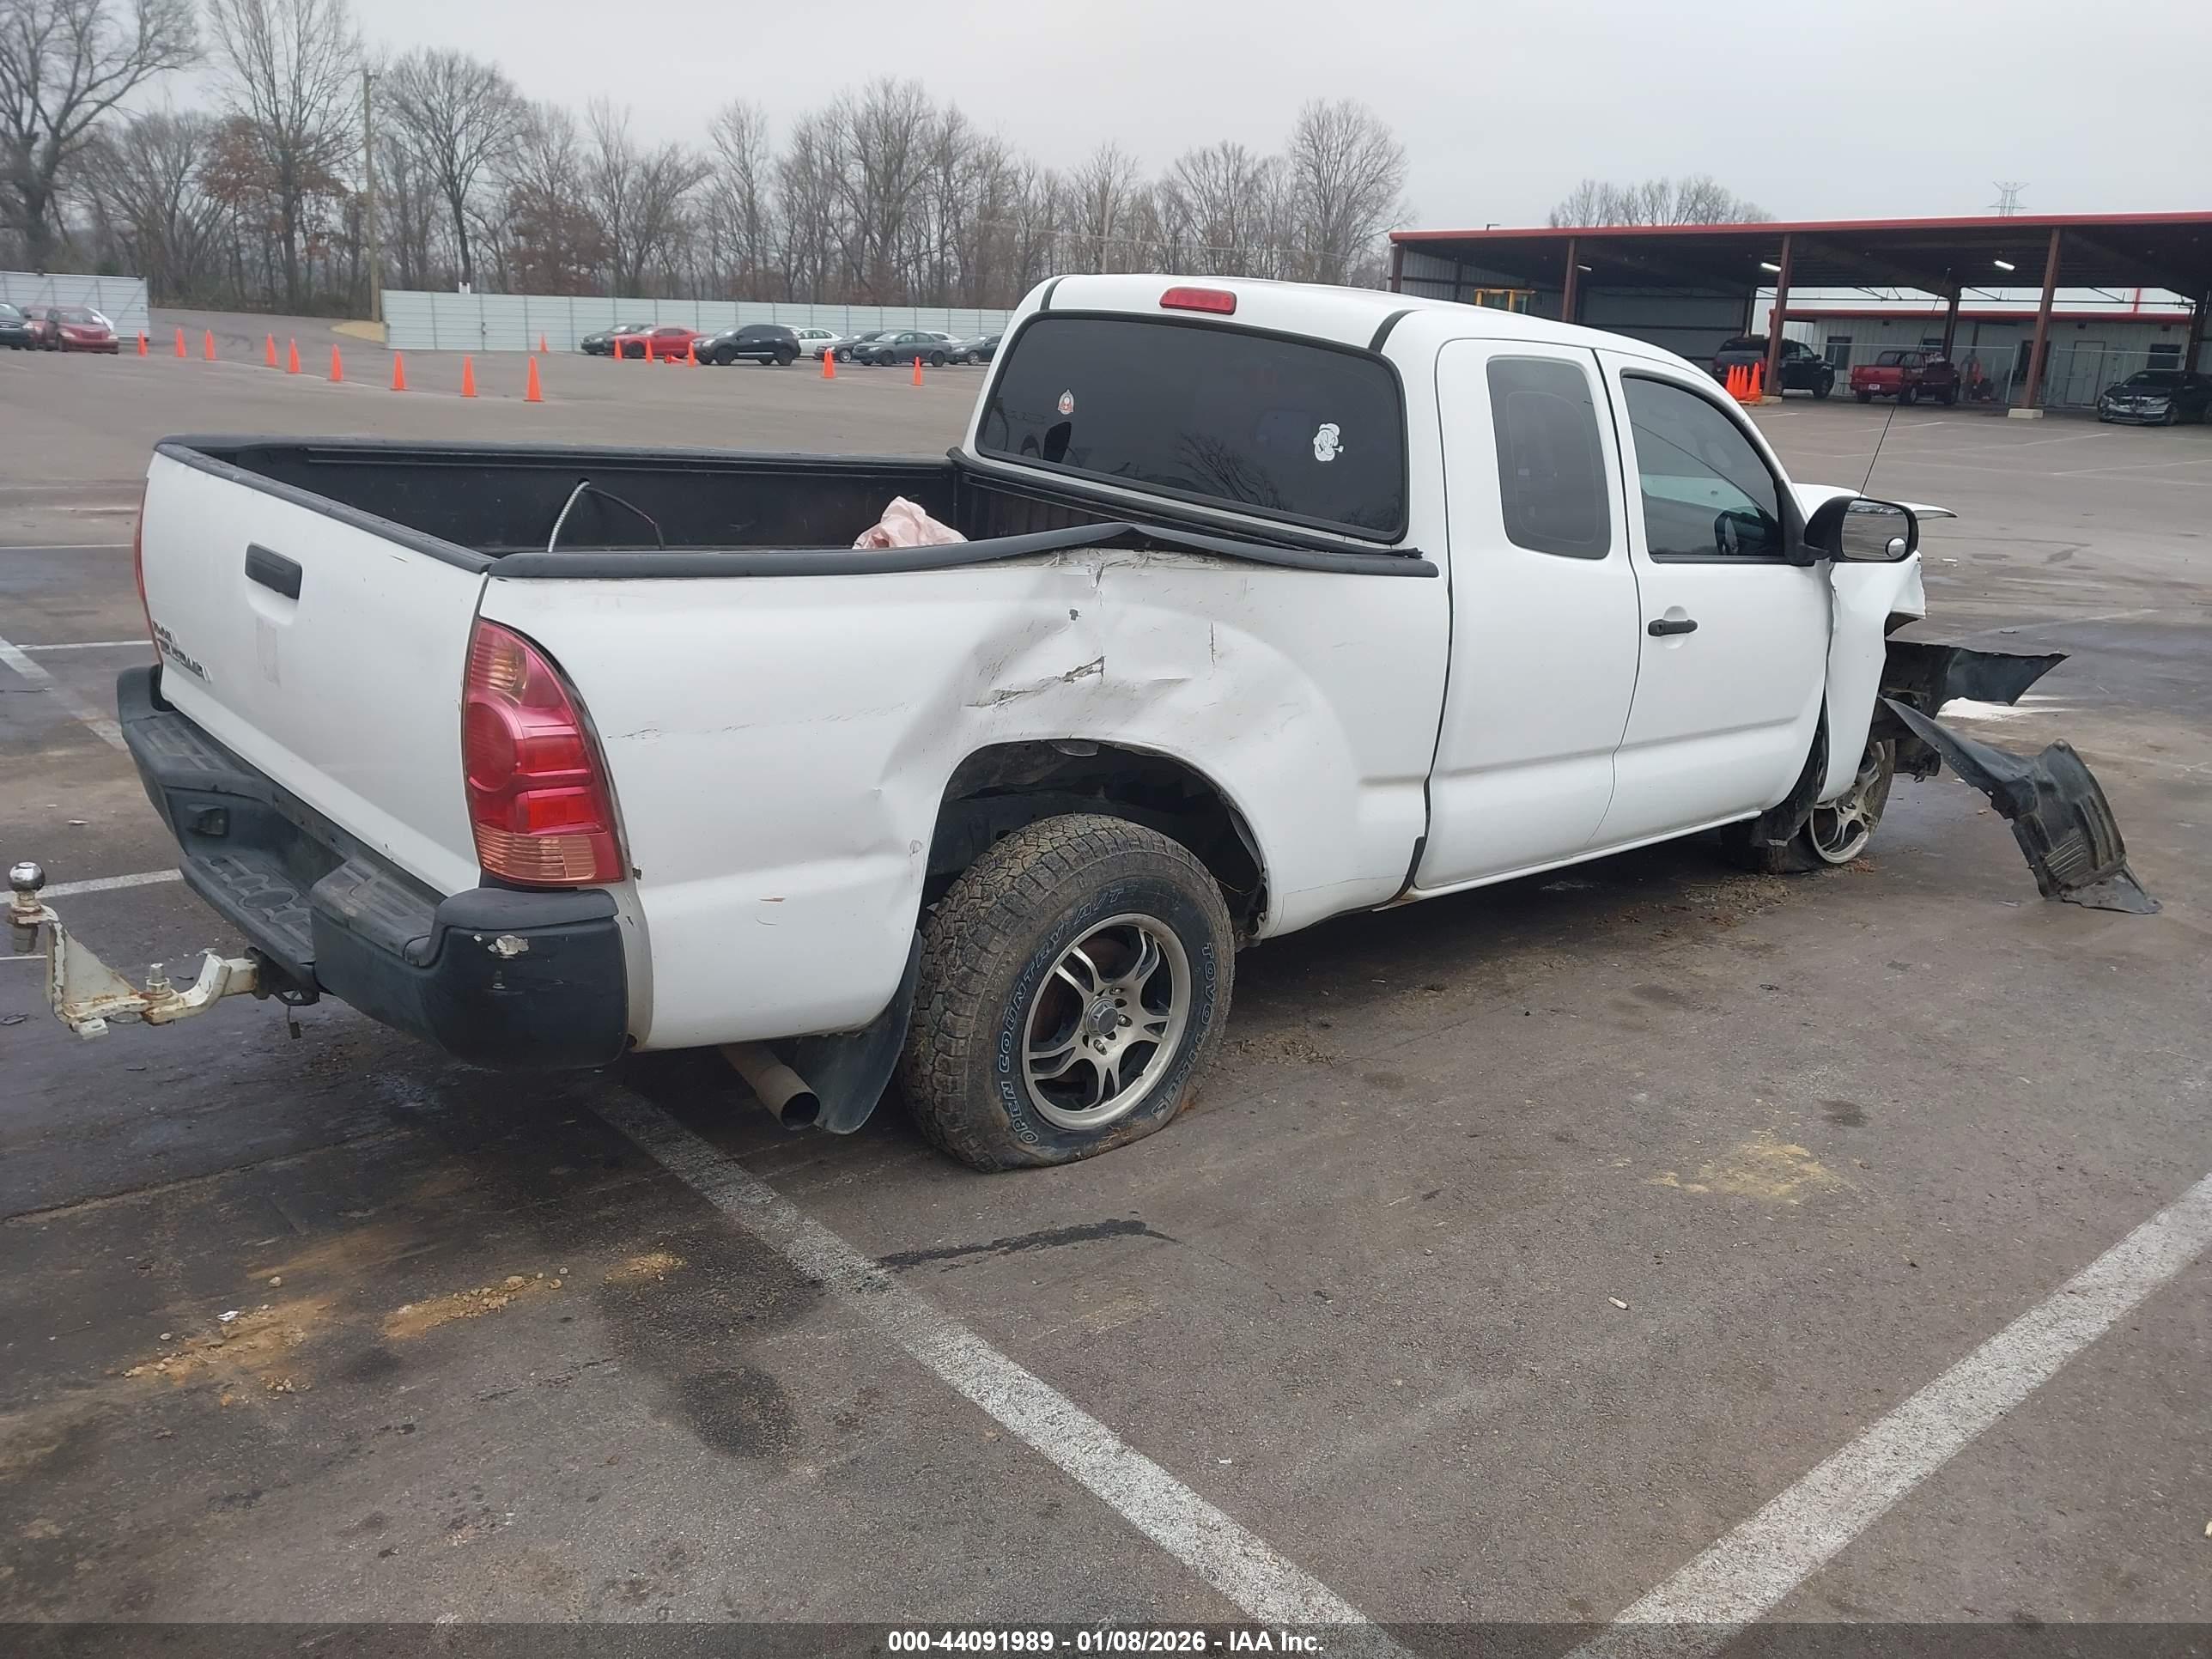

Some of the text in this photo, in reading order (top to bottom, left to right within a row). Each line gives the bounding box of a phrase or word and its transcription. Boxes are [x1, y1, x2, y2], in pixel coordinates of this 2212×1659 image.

[999, 920, 1065, 1073] COUNTRY
[1152, 942, 1216, 1120] TOYO TIRES
[1000, 1081, 1038, 1144] OPEN
